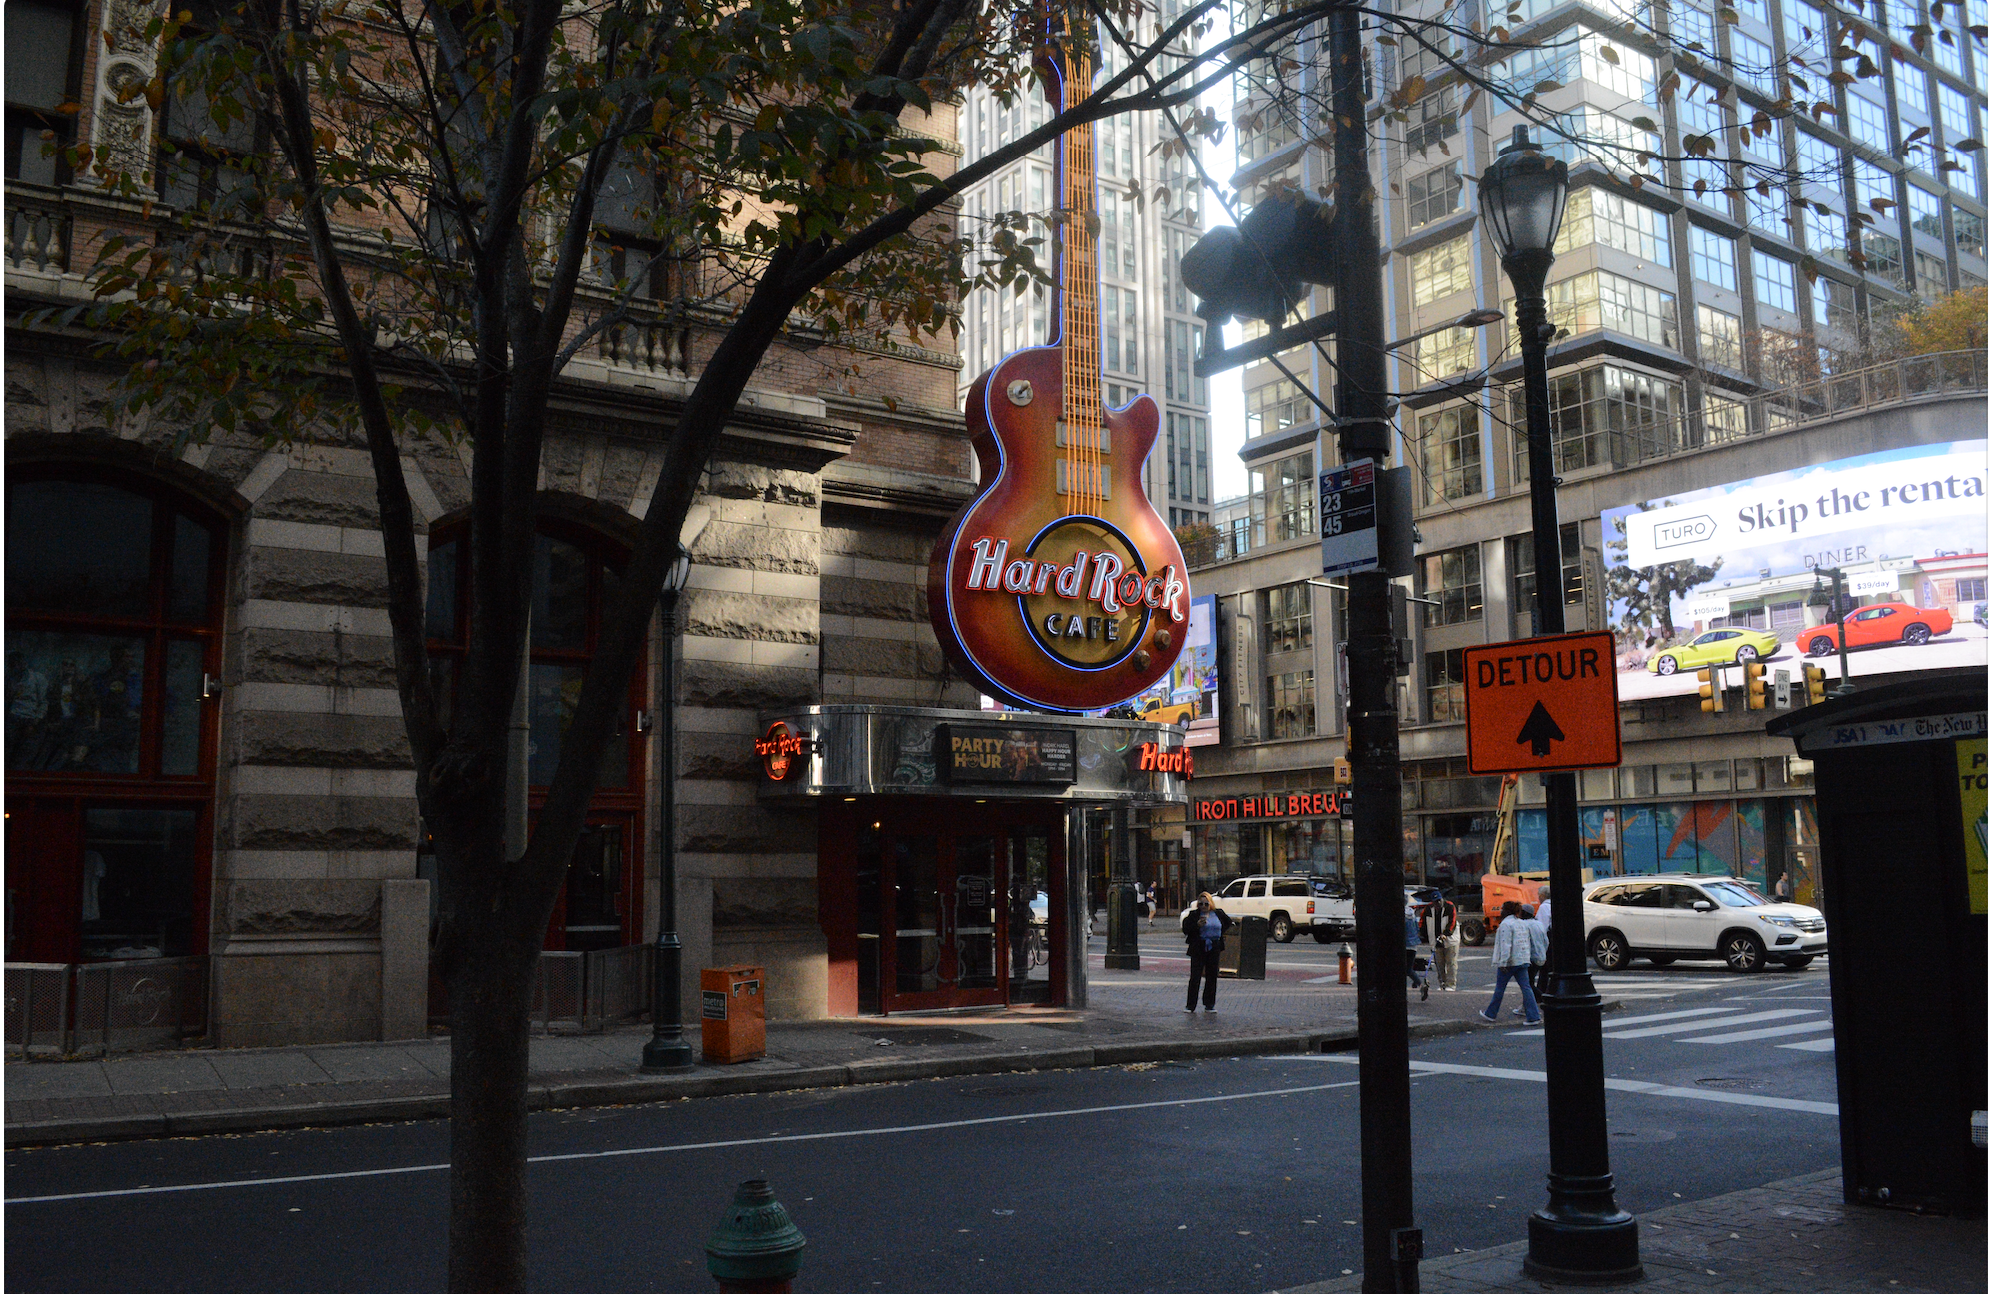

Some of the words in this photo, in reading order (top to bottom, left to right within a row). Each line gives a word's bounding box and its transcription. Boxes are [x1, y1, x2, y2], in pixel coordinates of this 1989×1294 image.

[1322, 493, 1342, 514] 23
[1738, 498, 1809, 534] Skip
[1816, 487, 1871, 519] the
[1880, 467, 1987, 508] renta
[1323, 514, 1343, 535] 45
[1661, 522, 1706, 541] TURO
[1804, 545, 1868, 569] DINER
[967, 536, 1088, 599] Hard
[1088, 550, 1184, 623] Rock
[1857, 581, 1890, 591] $39/day
[1044, 613, 1120, 641] CAFE
[1478, 648, 1600, 688] DETOUR
[1778, 673, 1788, 683] ONE
[1915, 718, 1941, 737] The
[1943, 716, 1973, 735] New
[755, 737, 777, 756] Hard
[951, 736, 1004, 753] PARTY
[1140, 742, 1184, 772] Hard
[1196, 799, 1238, 820] IRON
[1243, 796, 1284, 818] HILL
[1288, 792, 1348, 815] BREW
